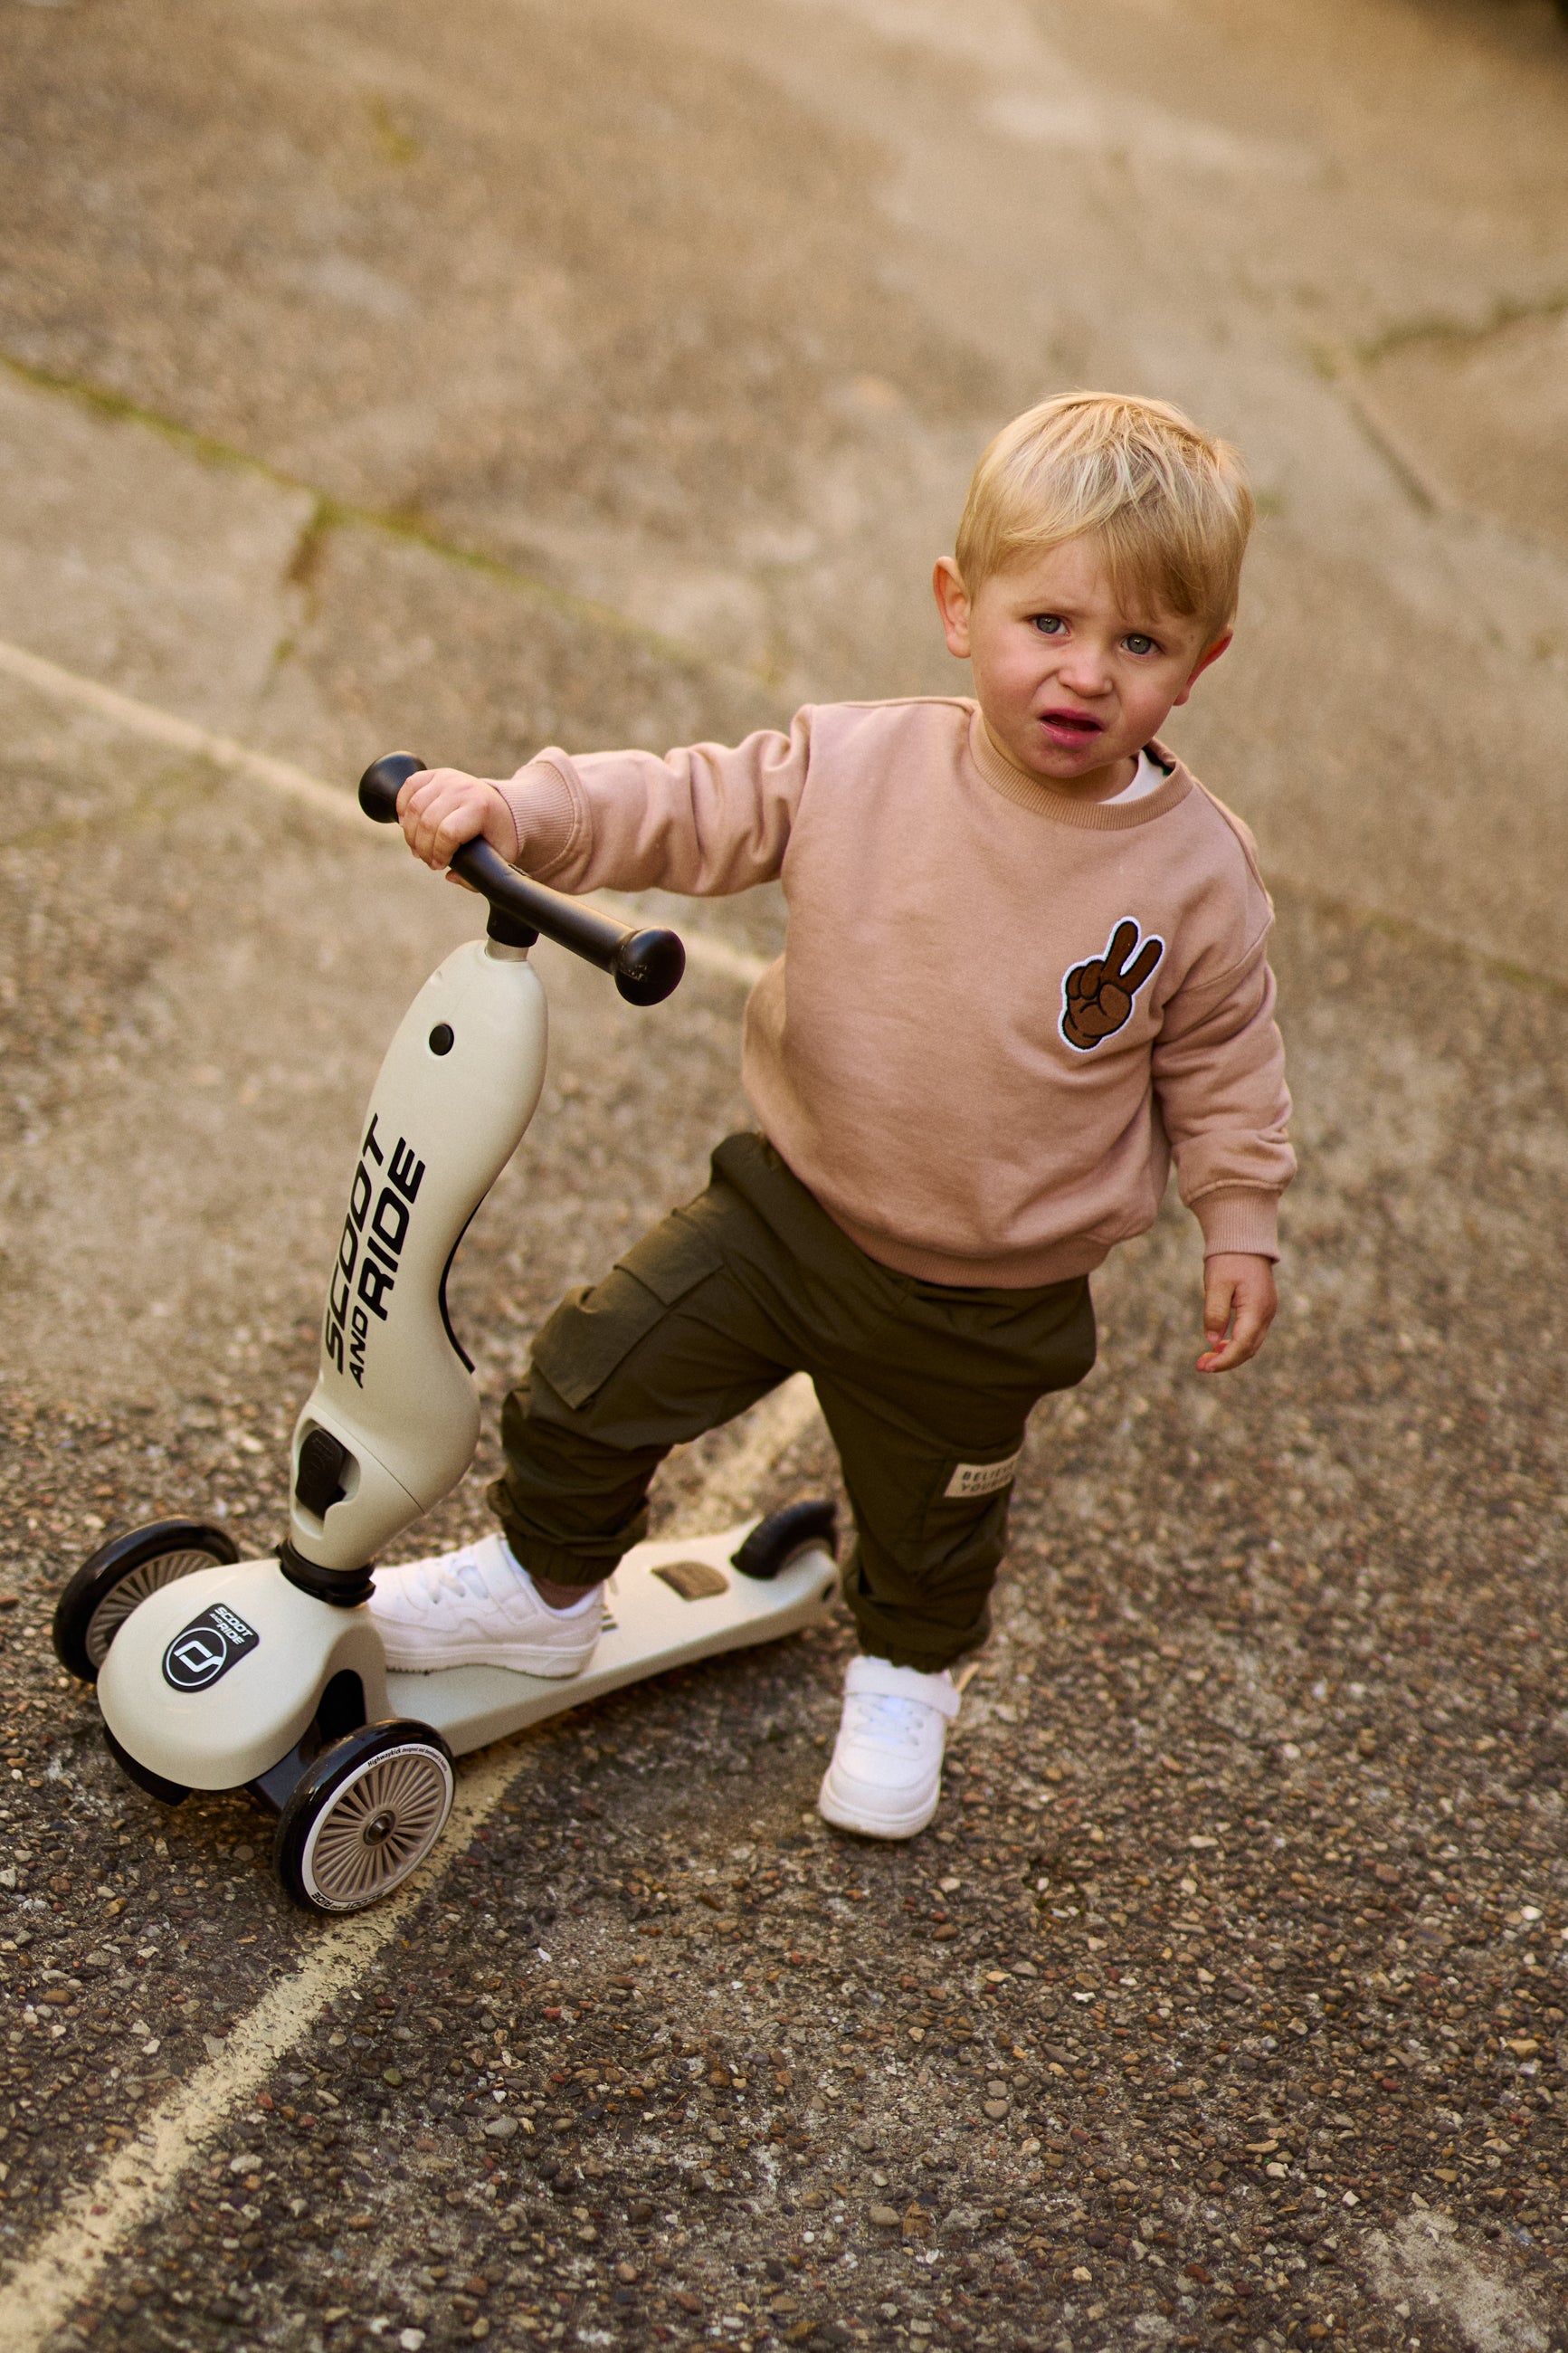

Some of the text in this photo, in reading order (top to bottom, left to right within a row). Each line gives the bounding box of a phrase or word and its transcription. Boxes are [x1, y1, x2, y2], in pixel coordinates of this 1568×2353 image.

[325, 1112, 384, 1375] SCOOT
[349, 1137, 426, 1389] AND RIDE
[214, 1606, 253, 1636] SCOOT
[216, 1622, 245, 1644] RIDE
[367, 1747, 401, 1767] Highwaykick
[311, 1891, 333, 1908] RIDE
